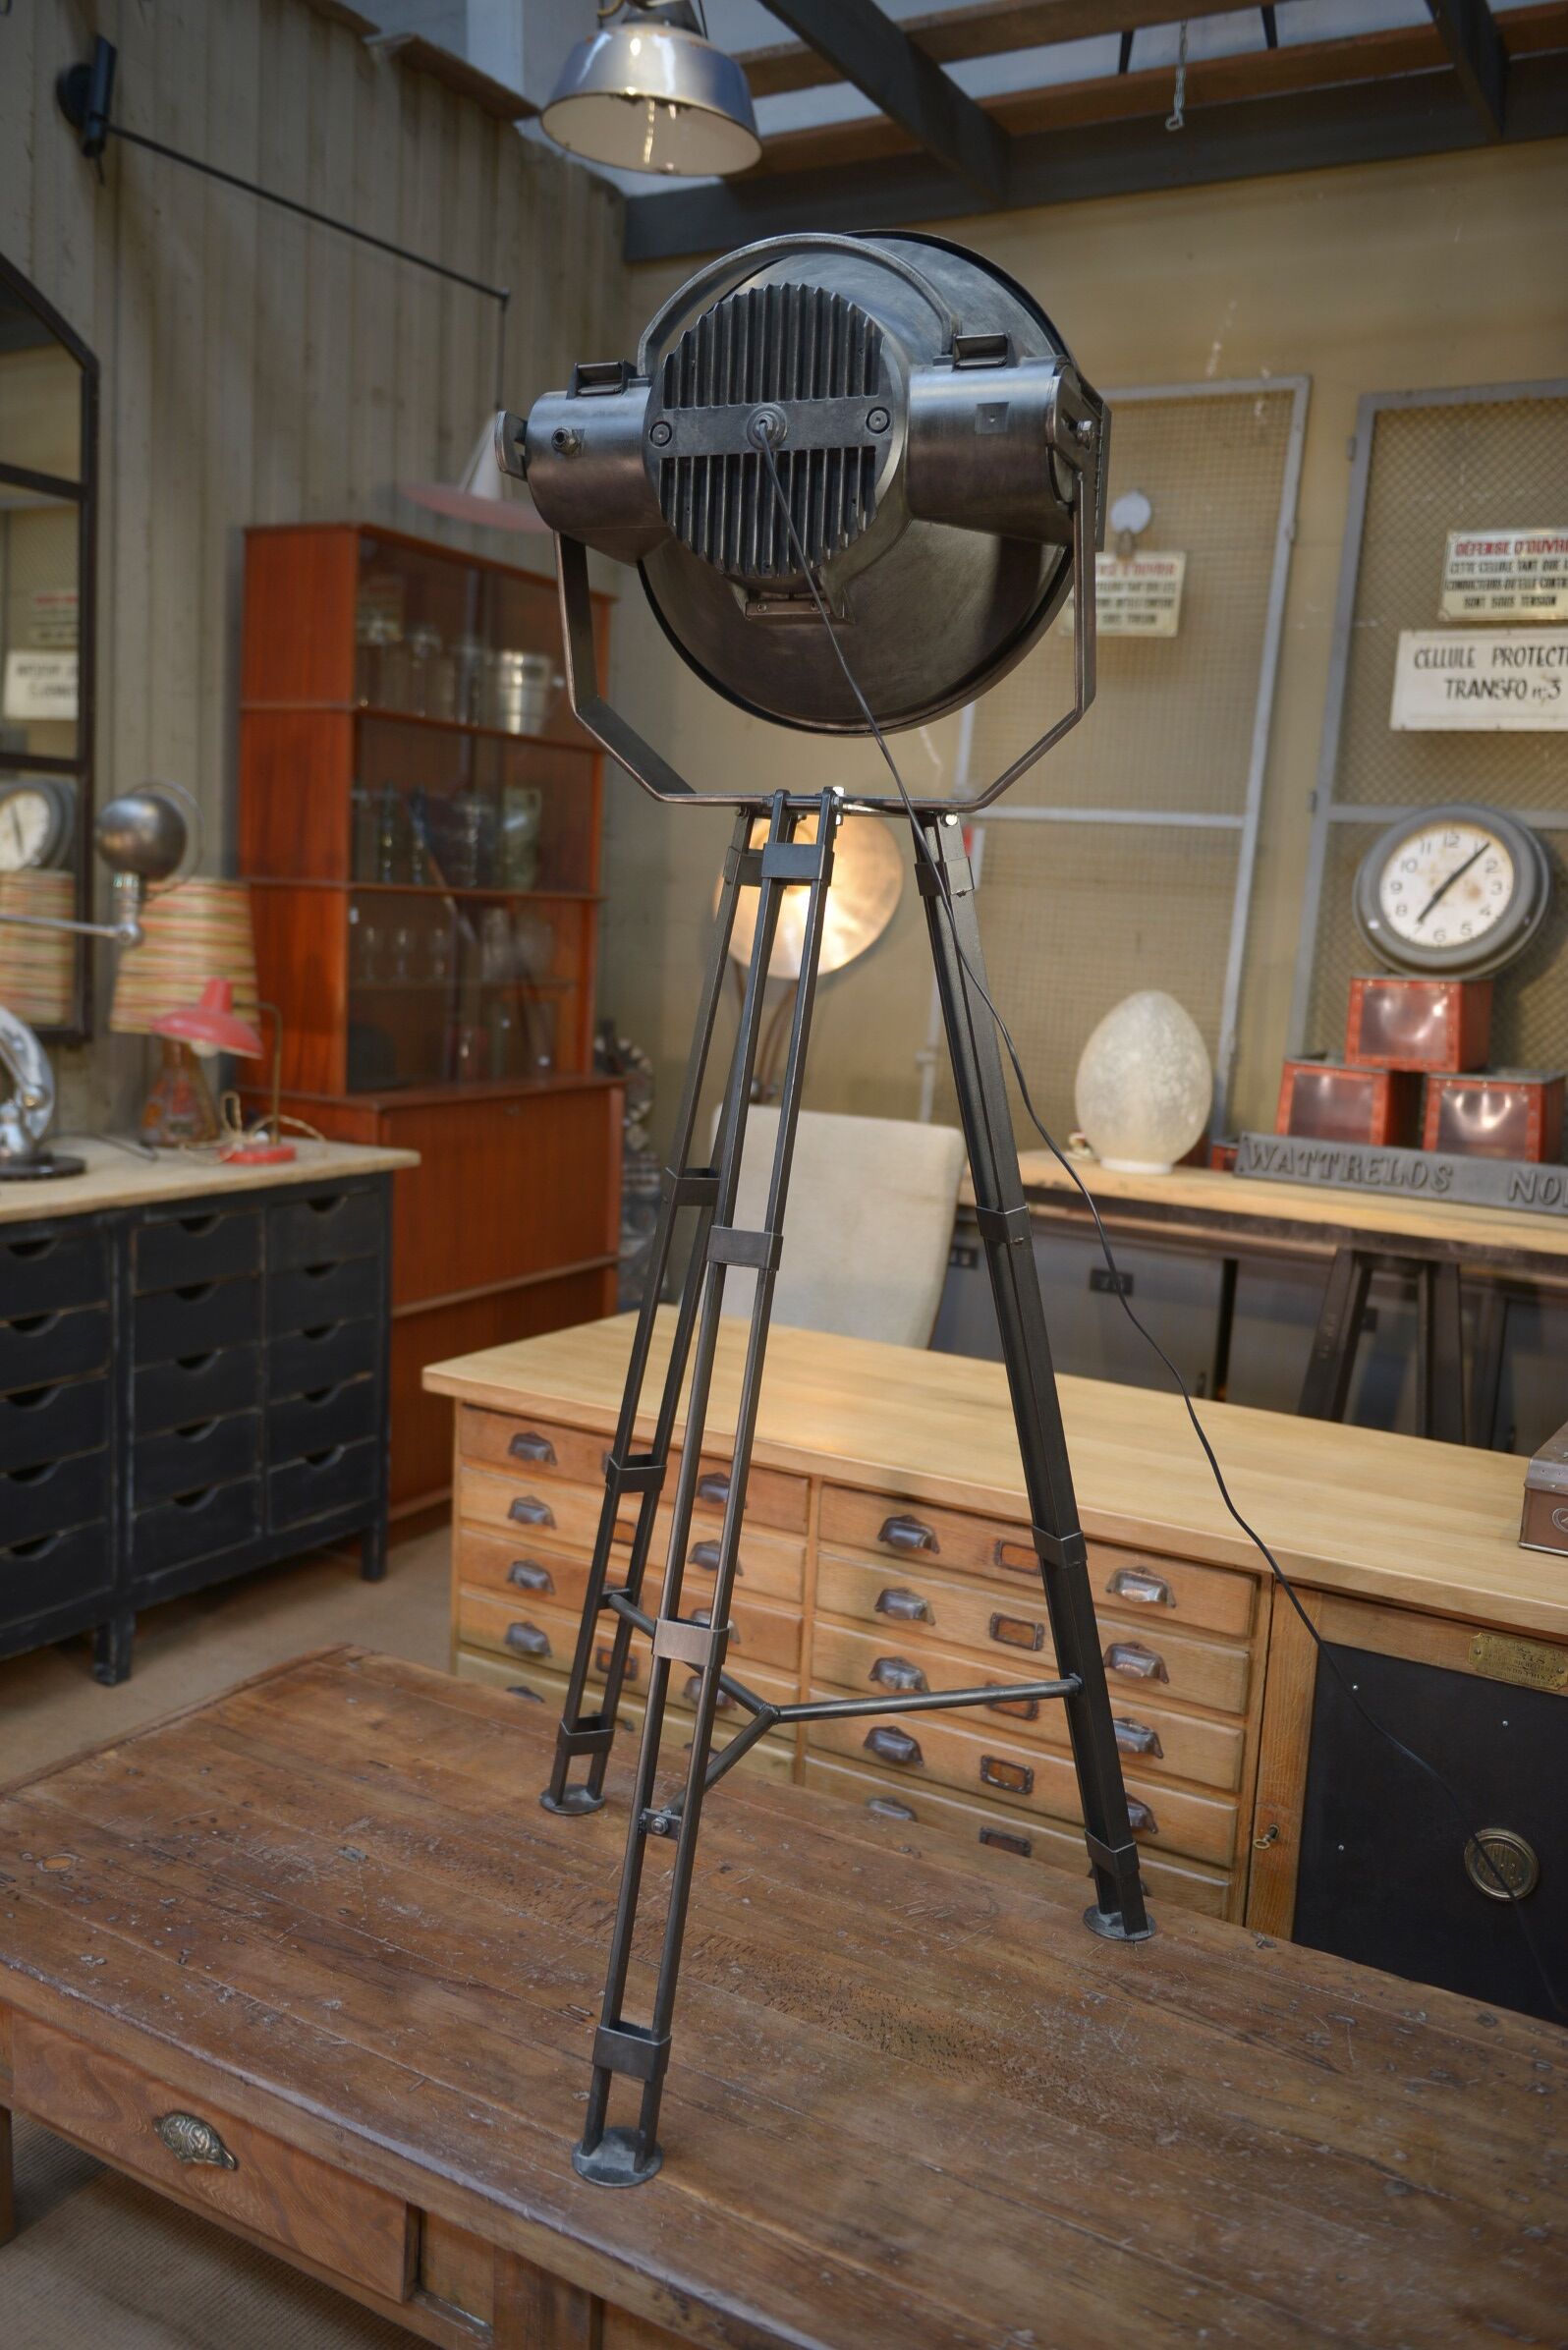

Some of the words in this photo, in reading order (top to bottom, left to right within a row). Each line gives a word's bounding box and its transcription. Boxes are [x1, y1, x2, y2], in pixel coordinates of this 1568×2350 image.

[1414, 646, 1476, 669] CELLULE
[1444, 678, 1528, 699] TRANSFO
[1421, 839, 1431, 855] 11
[1443, 831, 1460, 849] 12
[1402, 858, 1419, 874] 10
[1485, 858, 1498, 873] 2
[1390, 880, 1403, 895] 9
[1491, 880, 1503, 896] 3
[1396, 903, 1408, 917] 8
[1479, 905, 1491, 918] 4
[1433, 927, 1447, 943] 6
[1461, 921, 1473, 935] 5
[1249, 1140, 1453, 1193] WATTRELOS
